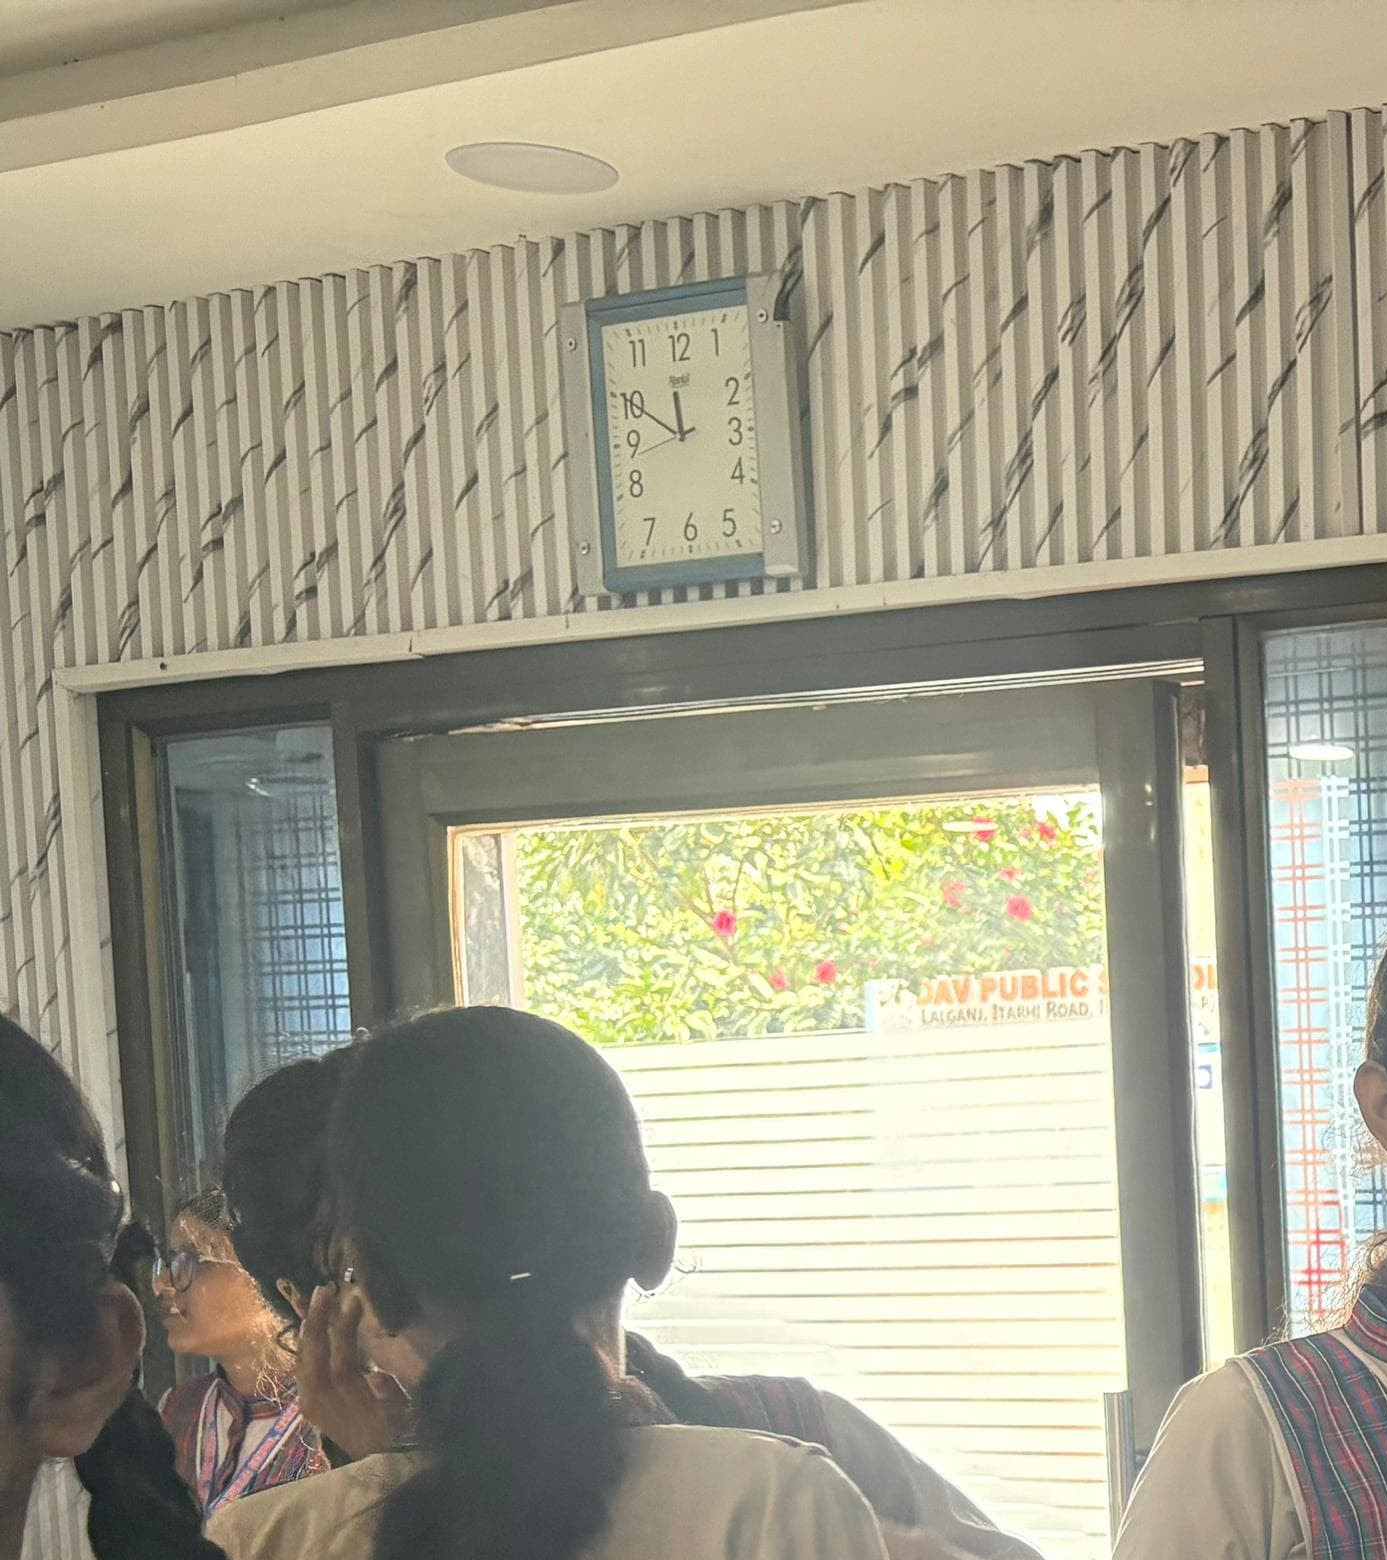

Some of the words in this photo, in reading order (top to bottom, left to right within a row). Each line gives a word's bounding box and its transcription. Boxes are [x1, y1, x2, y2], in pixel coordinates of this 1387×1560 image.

[629, 338, 646, 368] 11
[668, 333, 690, 362] 12
[711, 328, 719, 356] 1
[725, 377, 740, 405] 2
[627, 430, 640, 458] 9
[728, 417, 742, 446] 3
[629, 470, 643, 498] 8
[730, 457, 745, 485] 4
[643, 517, 656, 546] 7
[684, 512, 698, 541] 6
[722, 509, 736, 537] 5
[980, 970, 1089, 1003] PUBLIC
